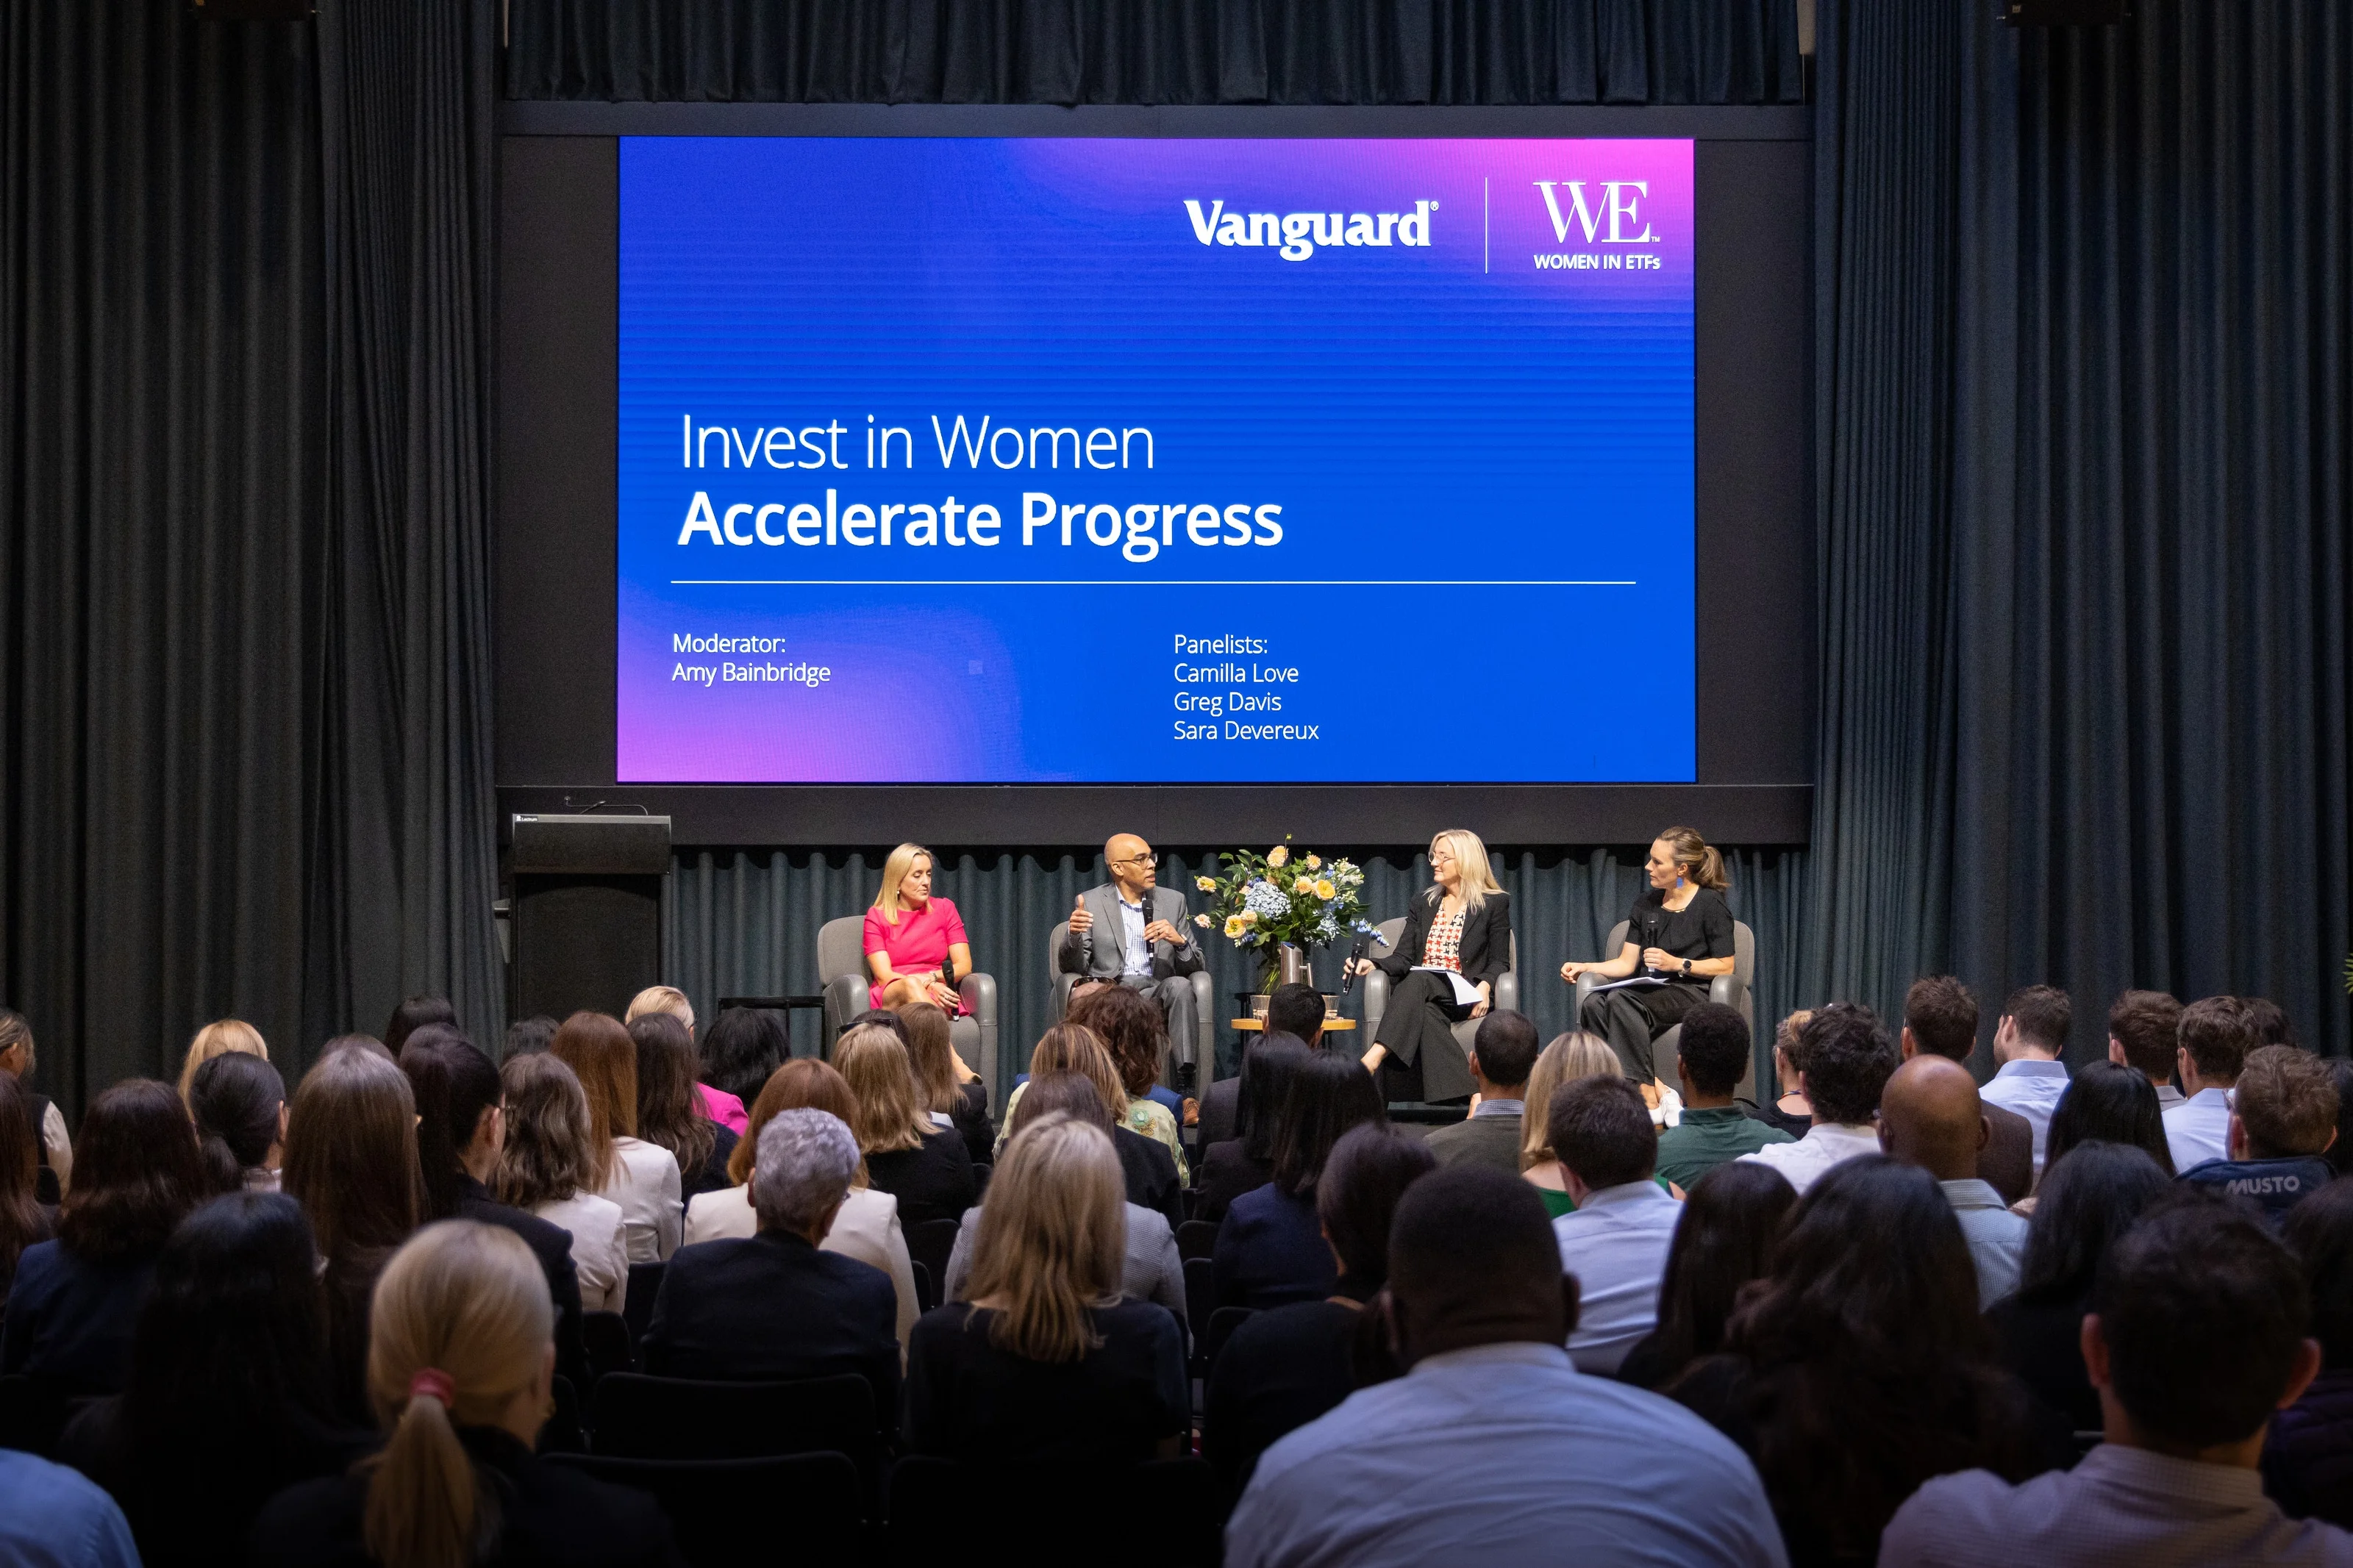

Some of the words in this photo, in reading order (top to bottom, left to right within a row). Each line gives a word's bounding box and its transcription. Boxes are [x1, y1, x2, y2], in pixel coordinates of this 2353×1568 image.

[1534, 254, 1599, 270] WOMEN
[1603, 254, 1621, 270] IN
[1626, 254, 1661, 270] ETFs
[682, 414, 849, 470] Invest
[867, 414, 913, 469] in
[931, 415, 1154, 470] Women
[677, 489, 1001, 547] Accelerate
[1022, 492, 1284, 563] Progress
[674, 632, 786, 653] Moderator:
[1175, 634, 1268, 654] Panelists:
[671, 662, 718, 687] Amy
[722, 662, 831, 687] Bainbridge
[1174, 663, 1246, 683] Camilla
[1253, 663, 1299, 683] Love
[1174, 692, 1223, 717] Greg
[1229, 692, 1282, 711] Davis
[1174, 720, 1218, 740] Sara
[1225, 720, 1319, 740] Devereux
[2225, 1175, 2300, 1195] MUSTO
